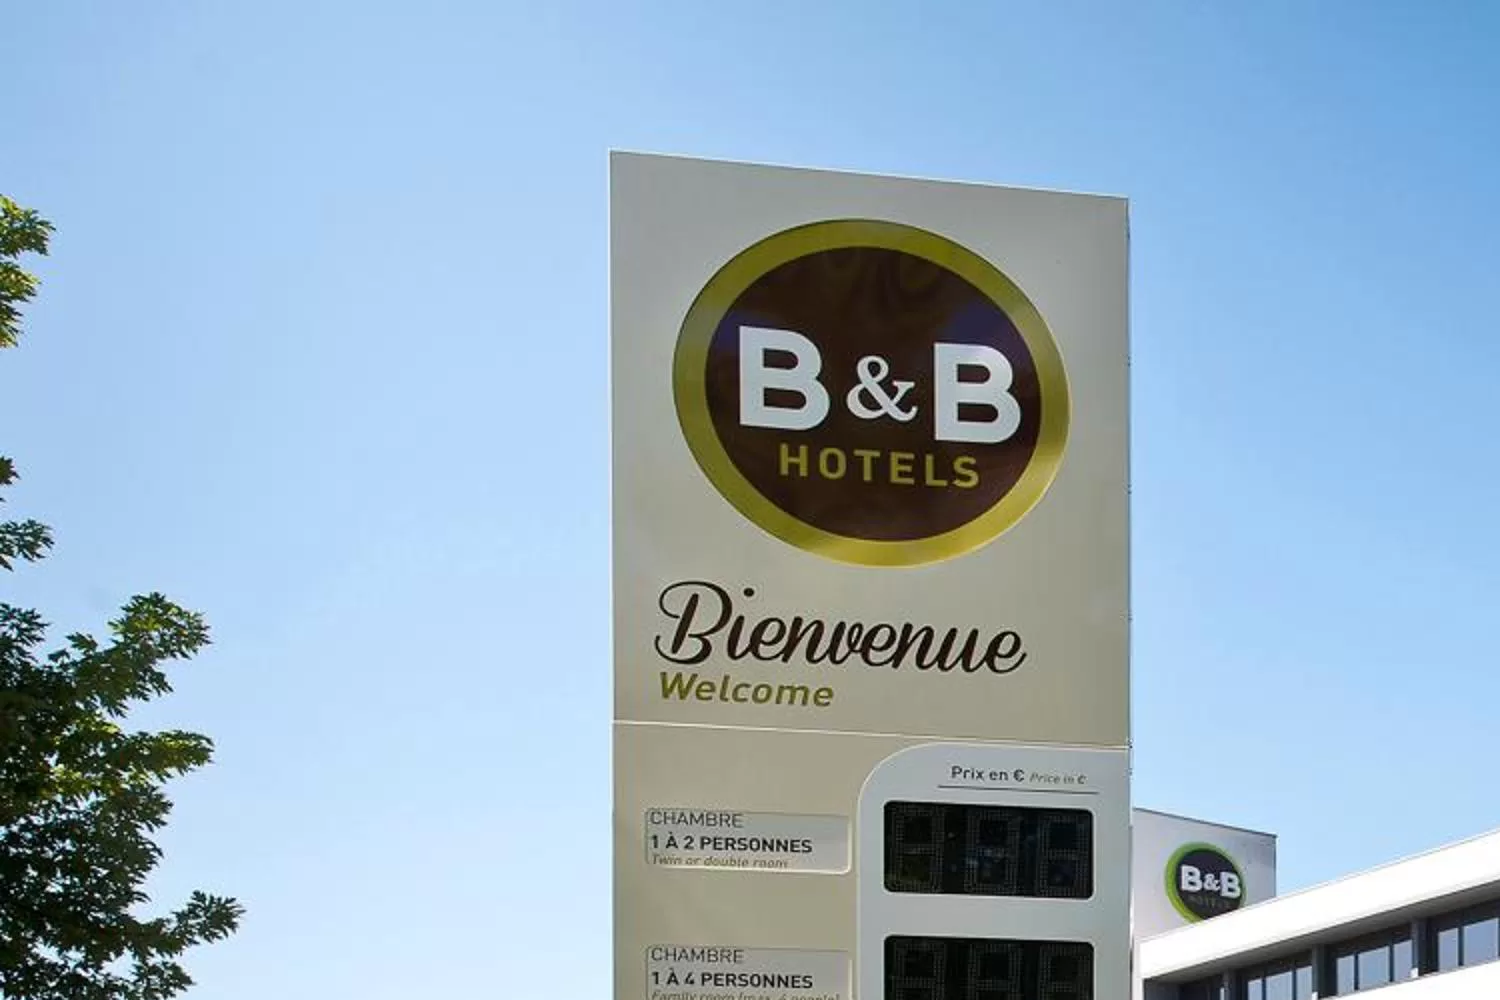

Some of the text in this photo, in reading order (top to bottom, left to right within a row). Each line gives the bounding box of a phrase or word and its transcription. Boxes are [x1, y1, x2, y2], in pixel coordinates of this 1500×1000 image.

[779, 443, 980, 489] HOTELS
[654, 580, 1027, 675] Bienvenue
[659, 671, 834, 707] Welcome
[951, 765, 1025, 782] Prix en €
[1029, 771, 1061, 784] Price
[650, 810, 745, 828] CHAMBRE
[652, 831, 813, 853] 1 À 2 PERSONNES
[652, 854, 788, 868] Twin or double room
[1180, 864, 1241, 899] B&B
[650, 947, 745, 964] CHAMBRE
[652, 967, 813, 989] 1 À 4 PERSONNES
